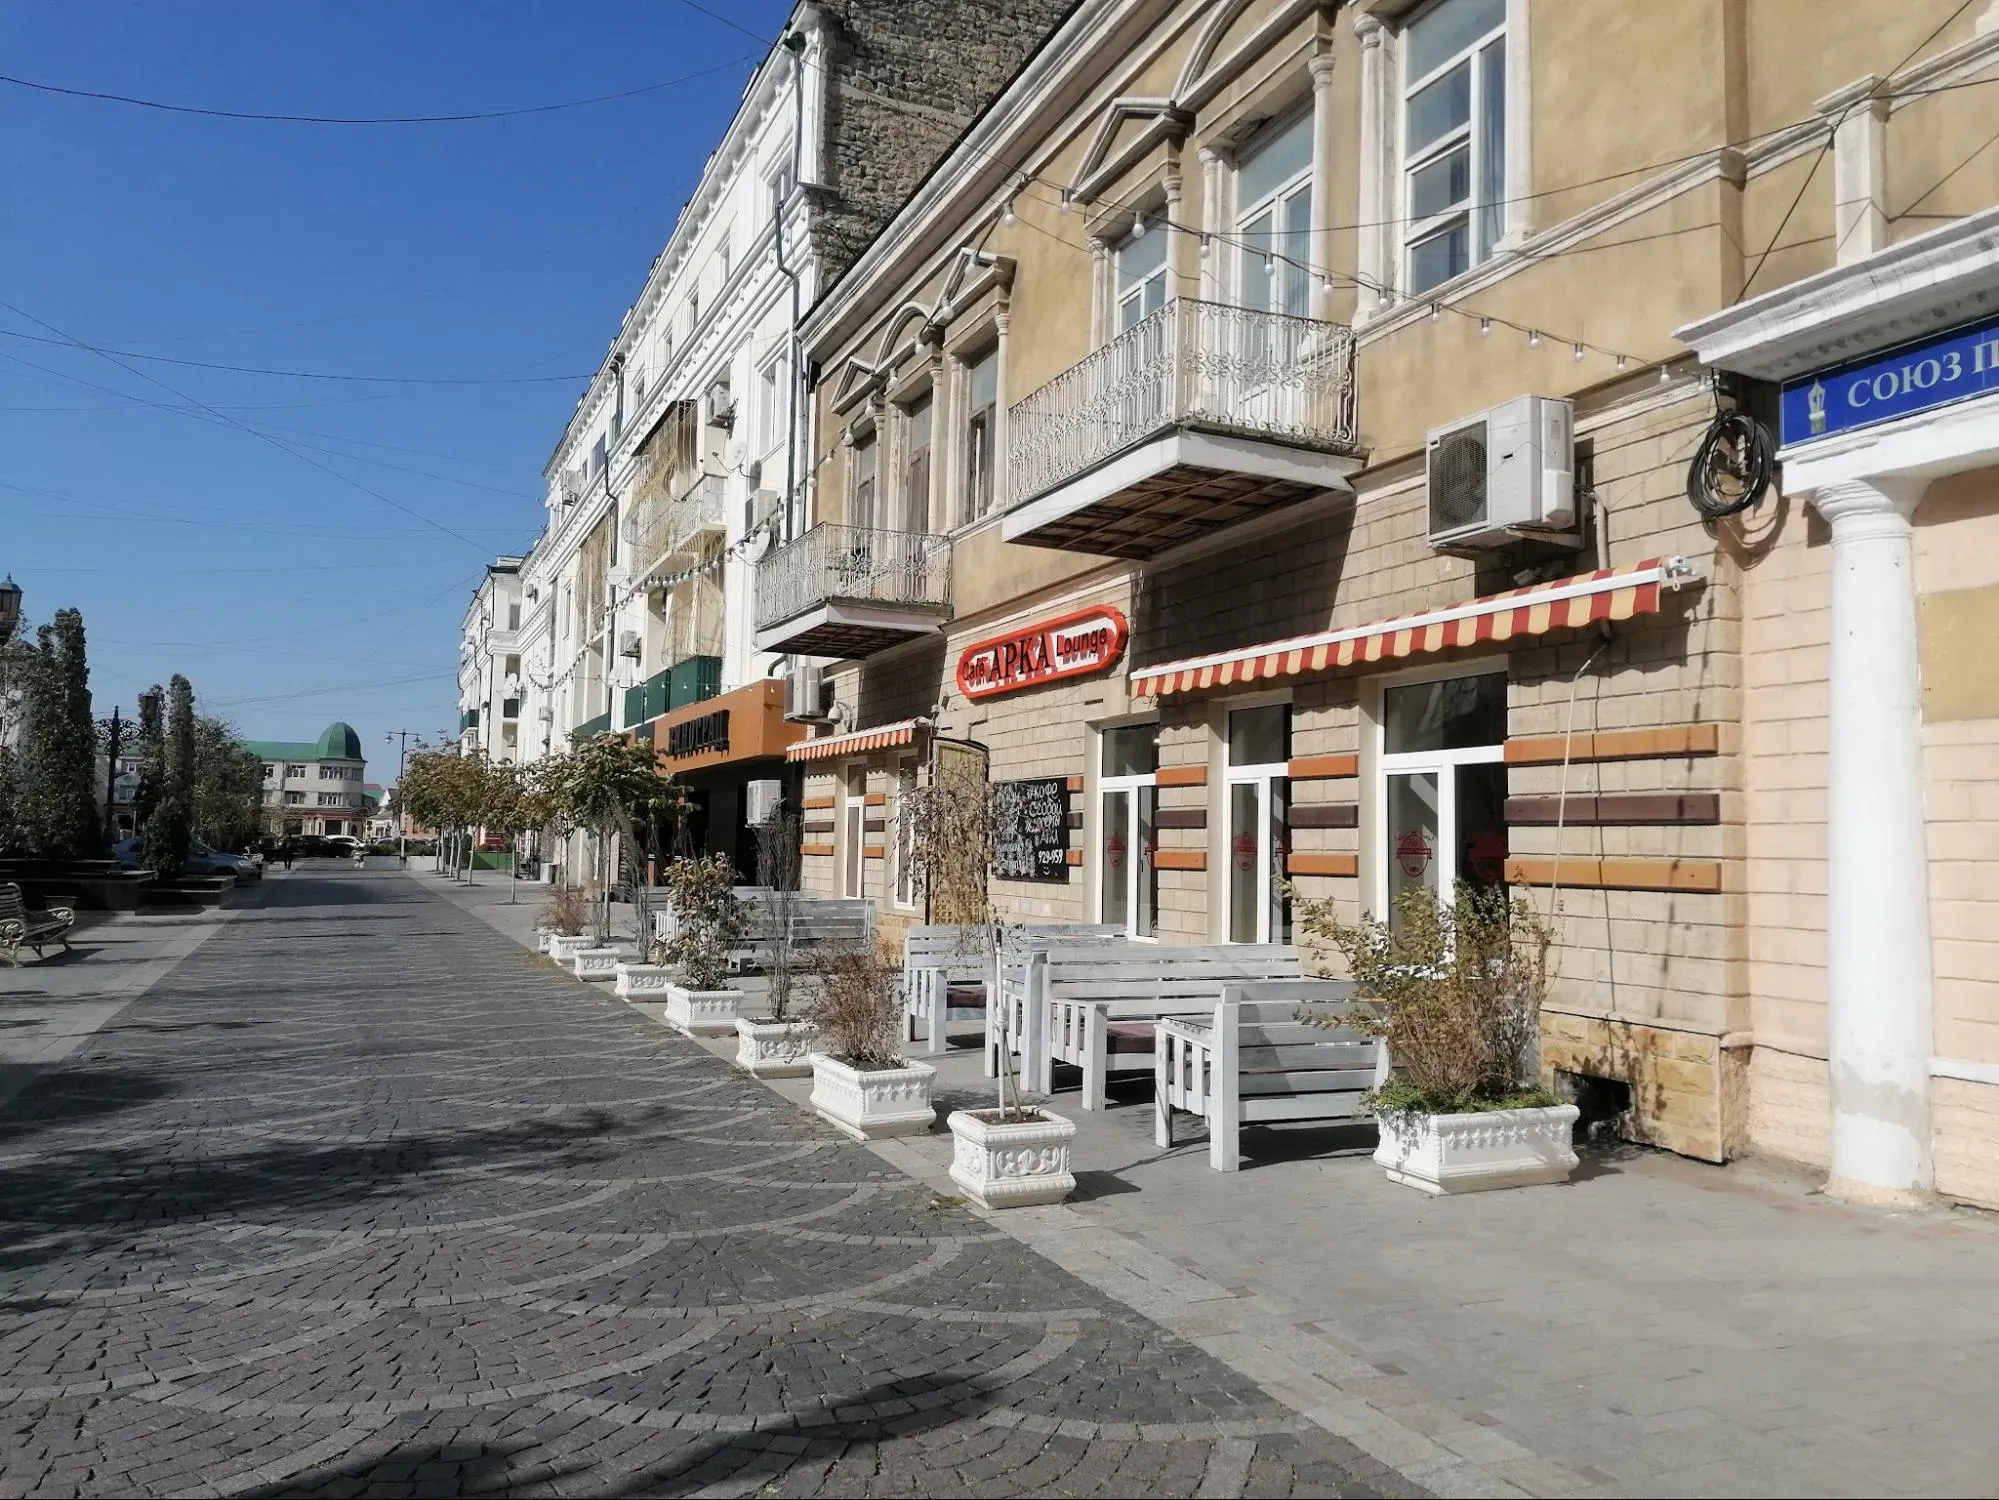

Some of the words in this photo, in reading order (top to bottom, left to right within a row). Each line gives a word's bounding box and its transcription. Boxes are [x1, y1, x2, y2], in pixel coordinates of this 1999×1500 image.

[1848, 351, 1962, 408] СОЮЗ
[988, 633, 1050, 680] АРКА
[1056, 627, 1108, 656] Lounge
